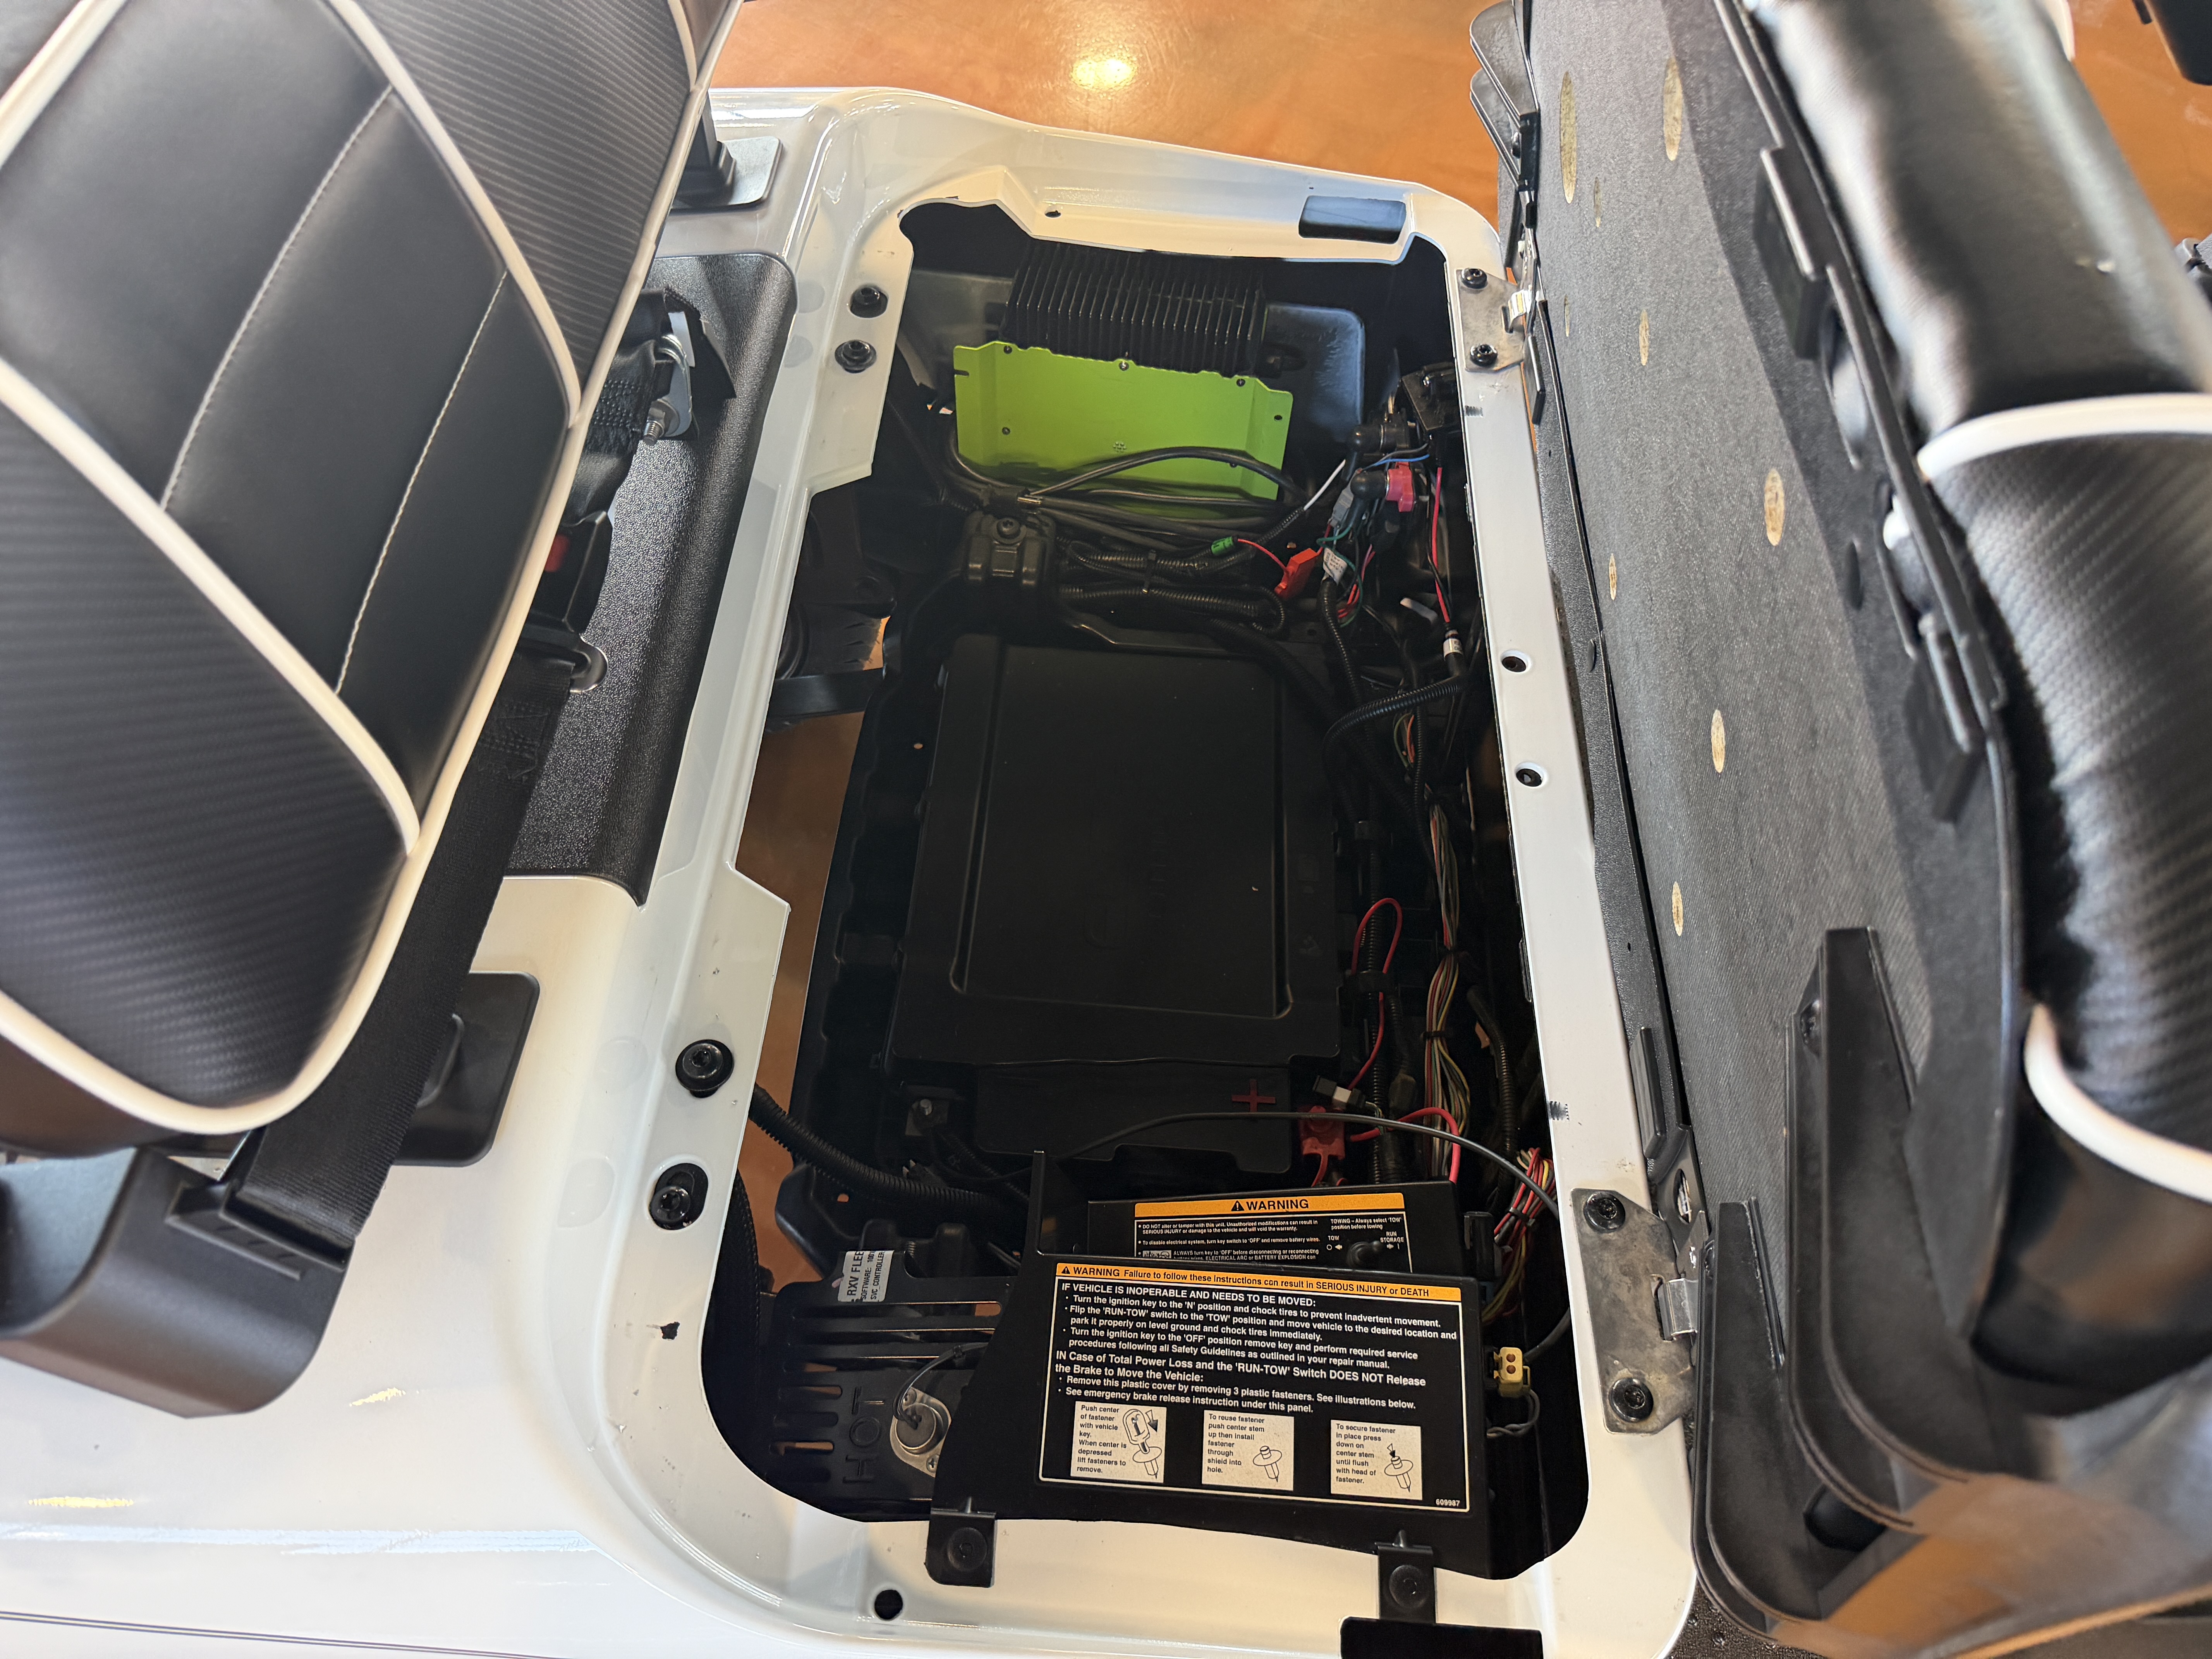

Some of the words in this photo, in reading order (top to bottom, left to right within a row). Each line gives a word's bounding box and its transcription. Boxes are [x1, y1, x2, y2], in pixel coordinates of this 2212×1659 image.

[1246, 1199, 1309, 1210] WARNING
[847, 1276, 859, 1296] RXV
[860, 1267, 871, 1300] SOFTWARE:
[1073, 1267, 1120, 1276] WARNING
[1124, 1269, 1151, 1278] Failure
[1163, 1272, 1187, 1280] follow
[1214, 1275, 1261, 1285] instructions
[1306, 1280, 1313, 1288] in
[1316, 1281, 1354, 1291] SERIOUS
[1356, 1284, 1387, 1294] INJURY
[1400, 1287, 1429, 1297] DEATH
[1073, 1283, 1113, 1293] VEHICLE
[1115, 1286, 1124, 1294] IS
[1126, 1286, 1187, 1297] INOPERABLE
[1189, 1290, 1209, 1299] AND
[1212, 1291, 1244, 1301] NEEDS
[1247, 1294, 1260, 1302] TO
[1262, 1295, 1275, 1304] BE
[1278, 1296, 1316, 1307] MOVED:
[1070, 1305, 1085, 1315] Flip
[1150, 1310, 1177, 1319] switch
[1190, 1312, 1204, 1321] the
[1232, 1316, 1266, 1325] position
[1312, 1322, 1342, 1331] vehicle
[1355, 1324, 1369, 1333] the
[1370, 1326, 1402, 1335] desired
[1404, 1328, 1438, 1338] location
[1440, 1331, 1457, 1340] and
[1073, 1295, 1091, 1303] Turn
[1109, 1297, 1139, 1306] ignition
[1142, 1298, 1156, 1308] key
[1197, 1303, 1231, 1311] position
[1251, 1306, 1276, 1315] chock
[1279, 1308, 1297, 1316] tires
[1310, 1312, 1342, 1320] prevent
[1345, 1312, 1392, 1324] inadvertent
[1394, 1318, 1440, 1327] movement.
[1055, 1364, 1071, 1372] the
[1073, 1364, 1102, 1375] Brake
[1104, 1367, 1114, 1376] to
[1117, 1367, 1143, 1378] Move
[1146, 1369, 1162, 1379] the
[1164, 1370, 1203, 1382] Vehicle:
[1056, 1350, 1066, 1360] IN
[1069, 1351, 1093, 1361] Case
[1096, 1353, 1106, 1362] of
[1109, 1354, 1132, 1364] Total
[1135, 1355, 1166, 1366] Power
[1169, 1358, 1193, 1368] Loss
[1195, 1361, 1214, 1369] and
[1217, 1361, 1232, 1371] the
[1293, 1367, 1326, 1378] Switch
[1329, 1370, 1358, 1381] DOES
[1362, 1372, 1383, 1383] NOT
[1386, 1374, 1426, 1386] Release
[1066, 1387, 1082, 1395] See
[1084, 1390, 1131, 1400] emergency
[1133, 1391, 1157, 1401] brake
[1159, 1394, 1190, 1403] release
[1192, 1396, 1239, 1407] instruction
[1241, 1400, 1267, 1408] under
[1269, 1401, 1285, 1410] this
[1287, 1404, 1313, 1412] panel.
[842, 1386, 884, 1484] HOT
[1208, 1439, 1235, 1448] fastener
[1087, 1457, 1118, 1465] fasteners
[1207, 1448, 1233, 1457] through
